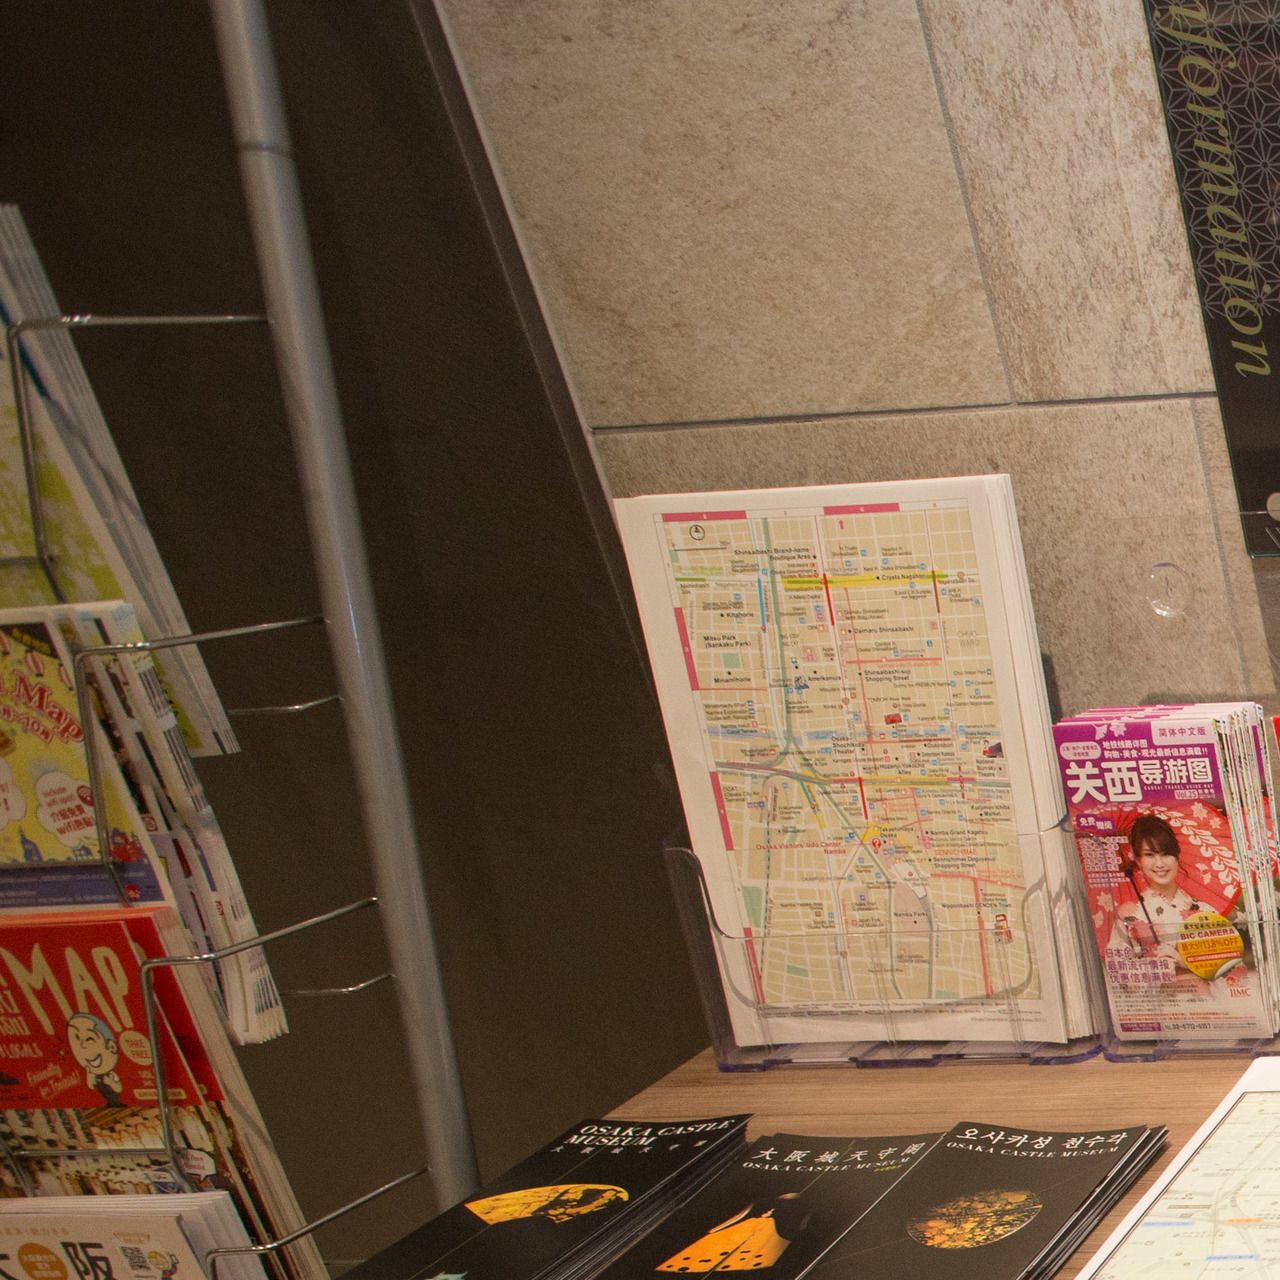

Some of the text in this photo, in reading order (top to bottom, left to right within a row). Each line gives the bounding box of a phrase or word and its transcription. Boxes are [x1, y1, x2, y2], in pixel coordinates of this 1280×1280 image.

[13, 669, 84, 744] Map
[1066, 758, 1214, 804] 关西导游图
[1198, 929, 1235, 939] CAMERA
[2, 943, 134, 1036] MAP
[579, 1119, 735, 1137] OSAKA CASTLE
[956, 1126, 1129, 1148] 오사카성 천수각
[563, 1135, 659, 1146] MUSEUM
[946, 1141, 1120, 1159] OSAKA CASTLE MUSEUM
[742, 1157, 912, 1173] OSAKA CASTLE MUSEUM
